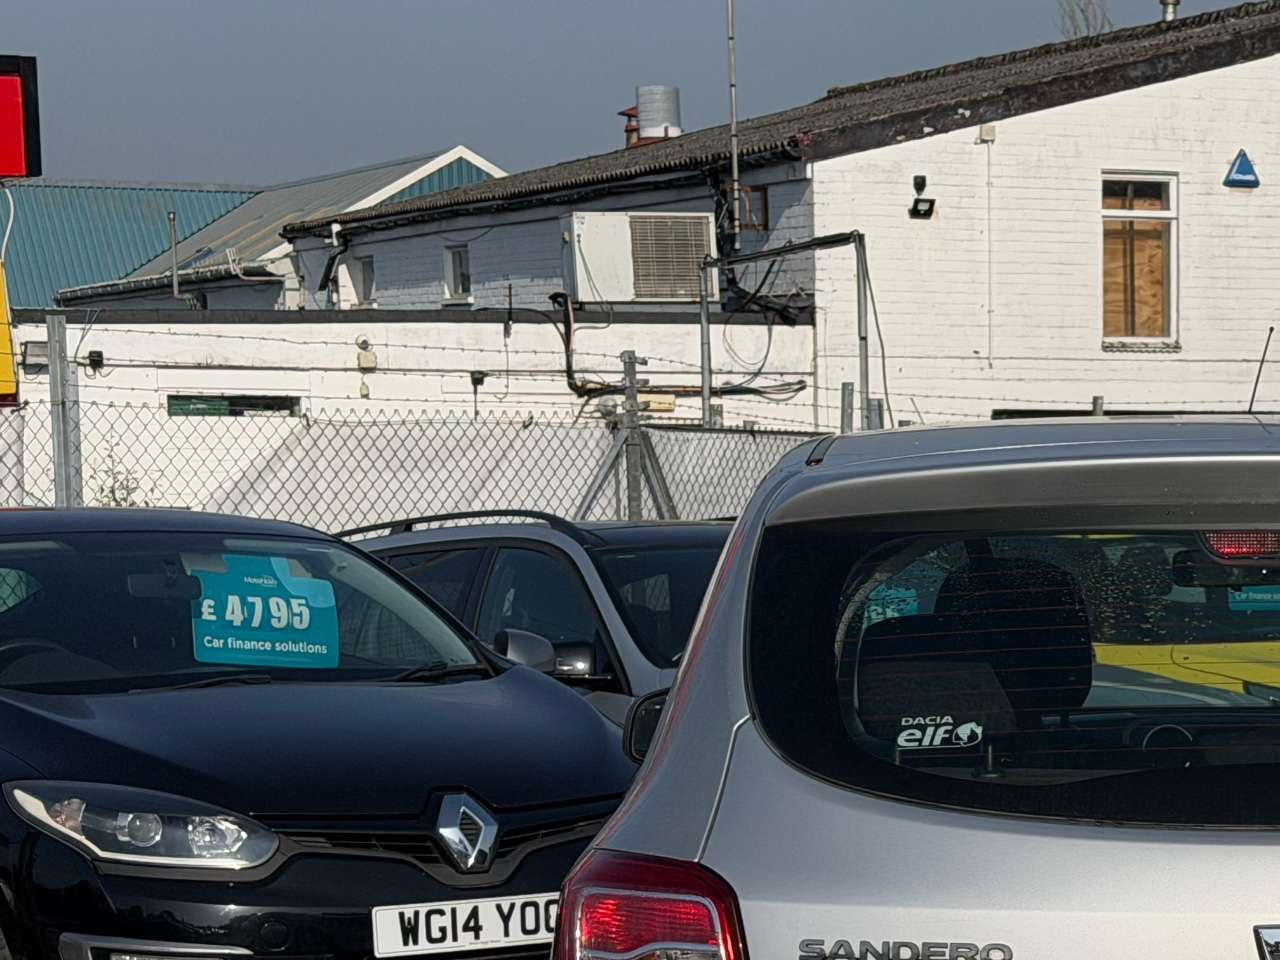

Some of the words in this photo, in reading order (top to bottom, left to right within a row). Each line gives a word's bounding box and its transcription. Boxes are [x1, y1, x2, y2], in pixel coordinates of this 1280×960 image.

[203, 636, 225, 648] Car
[227, 637, 272, 651] finance
[275, 641, 328, 655] solutions
[901, 715, 954, 726] DACIA
[897, 725, 953, 747] elf
[398, 905, 484, 947] WG14
